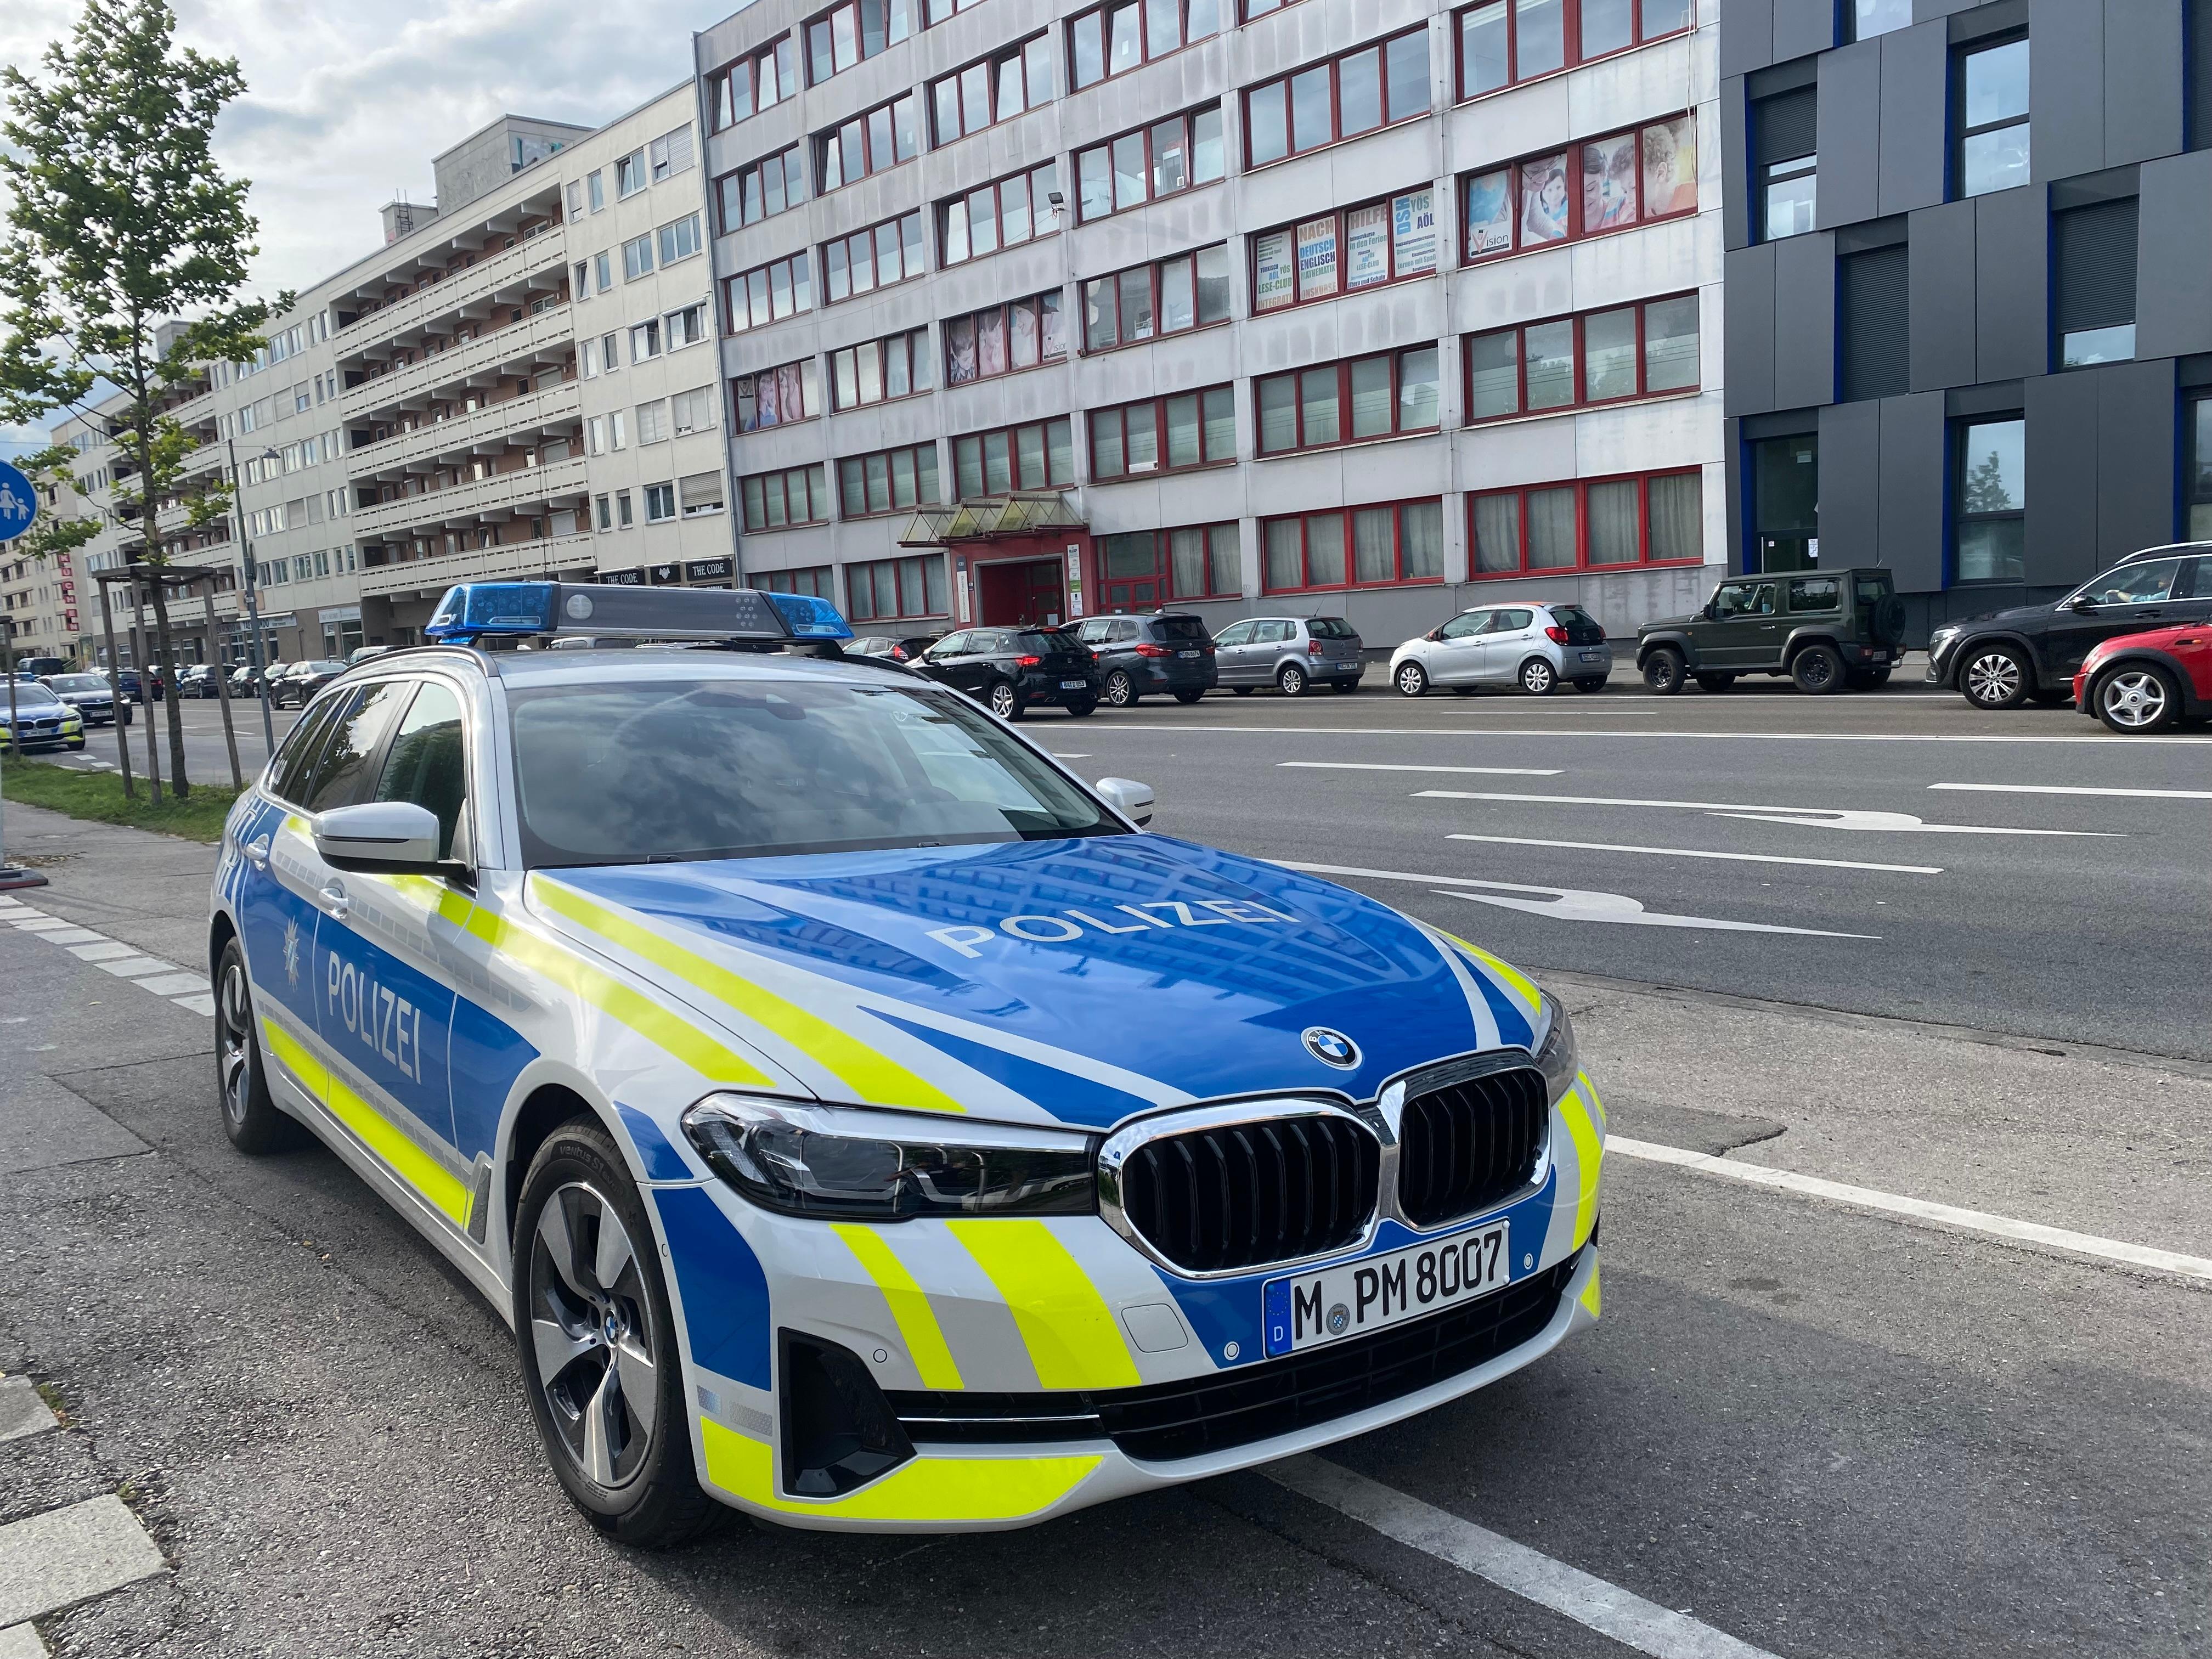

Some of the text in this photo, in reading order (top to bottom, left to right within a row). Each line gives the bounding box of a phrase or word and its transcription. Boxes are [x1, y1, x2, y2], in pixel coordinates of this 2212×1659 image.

[1410, 195, 1430, 212] YÖS
[1350, 206, 1387, 230] HILFE
[1396, 197, 1410, 235] DSH
[1417, 212, 1434, 229] AÖL
[1299, 219, 1334, 242] NACH
[1300, 239, 1334, 259] DEUTSCH
[1357, 239, 1367, 247] den
[1369, 235, 1387, 245] Ferien
[1472, 230, 1508, 253] Vision
[1280, 264, 1290, 274] YÖS
[1300, 251, 1335, 270] ENGLISCH
[1397, 258, 1414, 269] Lernen
[1269, 270, 1279, 281] AÖL
[1301, 263, 1335, 280] MATHEMATIK
[1370, 274, 1385, 283] Schule
[1259, 277, 1292, 294] LESE-CLUB
[1301, 282, 1336, 300] ONSKURSE
[1258, 294, 1292, 310] INTEGRATI
[692, 563, 725, 577] THE CODE
[606, 573, 638, 585] THE CODE
[924, 900, 1301, 959] POLIZEI
[329, 950, 421, 1085] POLIZEI
[1294, 1280, 1323, 1340] M
[1353, 1259, 1407, 1323] PM
[1415, 1229, 1503, 1304] 8007
[1273, 1325, 1284, 1342] D
